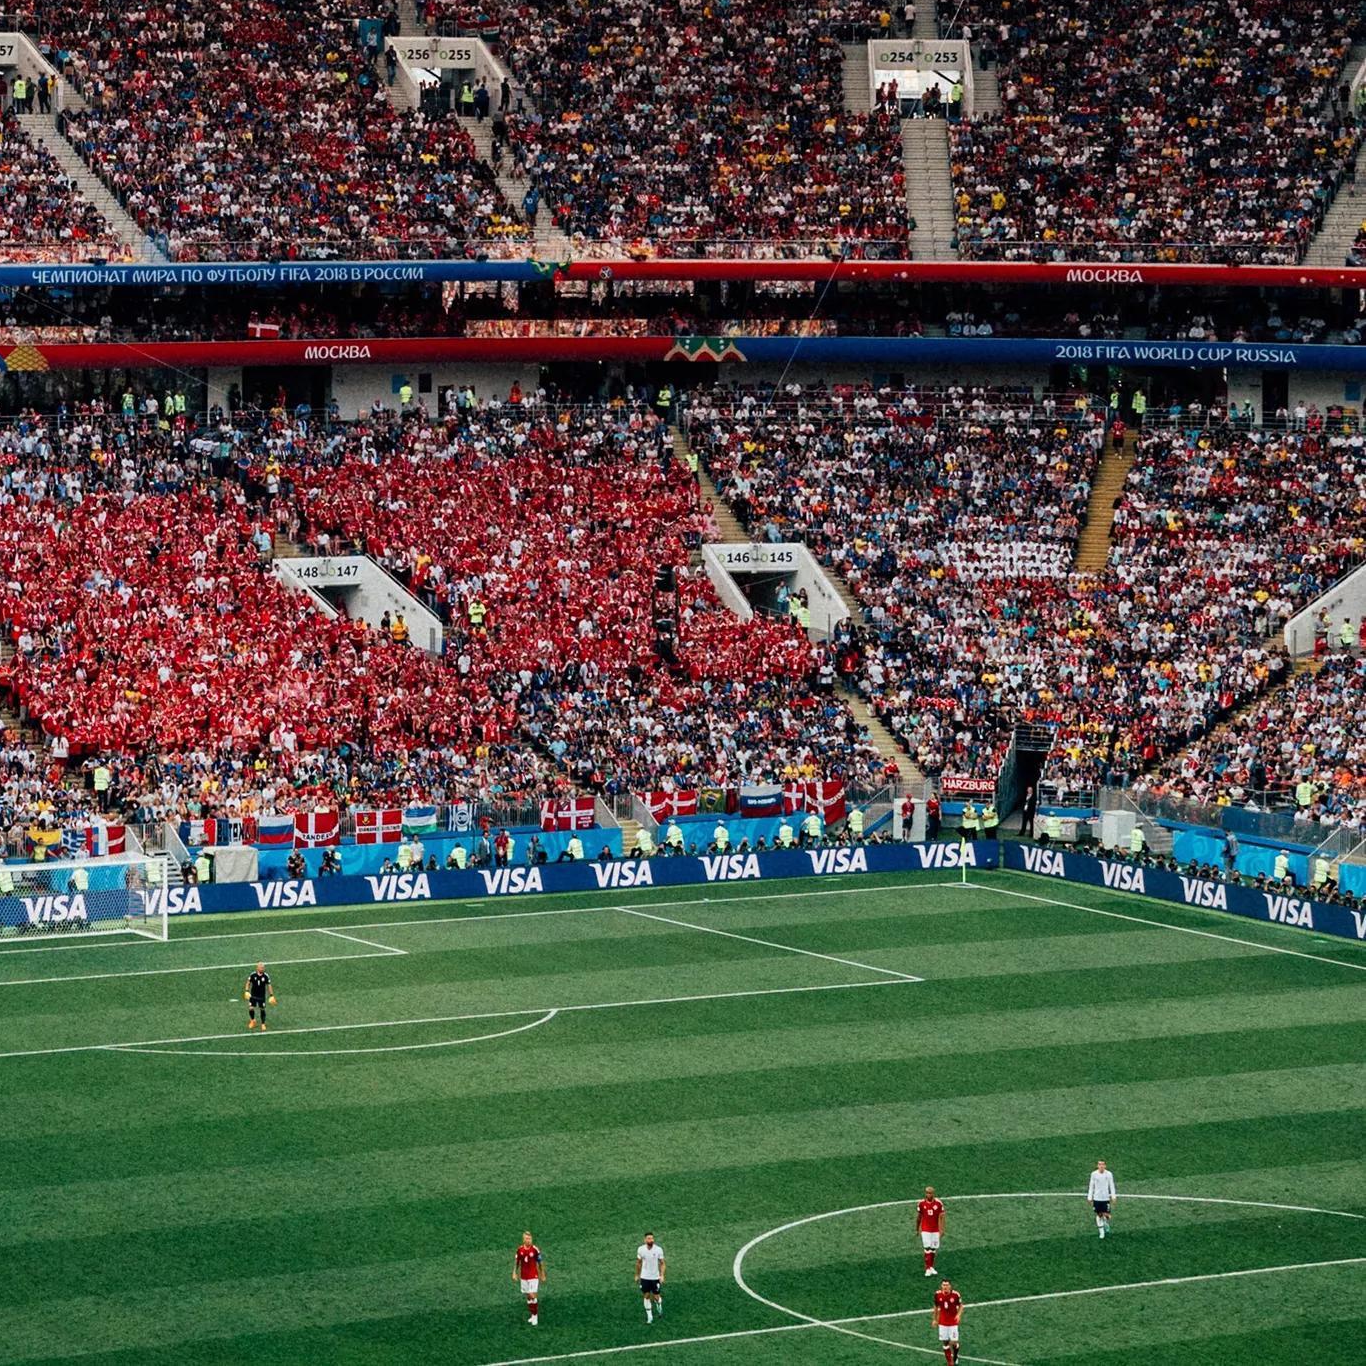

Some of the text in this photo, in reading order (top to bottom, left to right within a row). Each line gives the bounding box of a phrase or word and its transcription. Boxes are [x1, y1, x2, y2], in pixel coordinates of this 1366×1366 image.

[407, 49, 430, 60] 256
[448, 49, 471, 60] 255
[890, 52, 914, 63] 254
[934, 52, 957, 63] 253
[32, 267, 423, 283] ЧЕМПИОНАТ МИРА ПО ФУТБОЛУ FIFA 2018 В РОССИИ
[1066, 269, 1143, 283] МОСКВА
[304, 345, 371, 359] МОСКВА
[1055, 345, 1297, 363] 2018 FIFA WORLD CUP RUSSIA
[727, 552, 750, 563] 146
[769, 552, 793, 563] 145
[297, 567, 318, 578] 148
[337, 565, 358, 576] 147
[943, 779, 994, 790] HARZBURG
[805, 847, 868, 875] VISA
[913, 842, 977, 869] VISA
[1019, 844, 1065, 877] VISA
[589, 859, 653, 888] VISA
[698, 853, 761, 882] VISA
[1098, 860, 1145, 894] VISA
[364, 873, 431, 902] VISA
[478, 866, 543, 895] VISA
[138, 886, 202, 916] VISA
[250, 879, 316, 908] VISA
[1179, 876, 1227, 910] VISA
[20, 894, 88, 924] VISA
[1263, 892, 1313, 928] VISA
